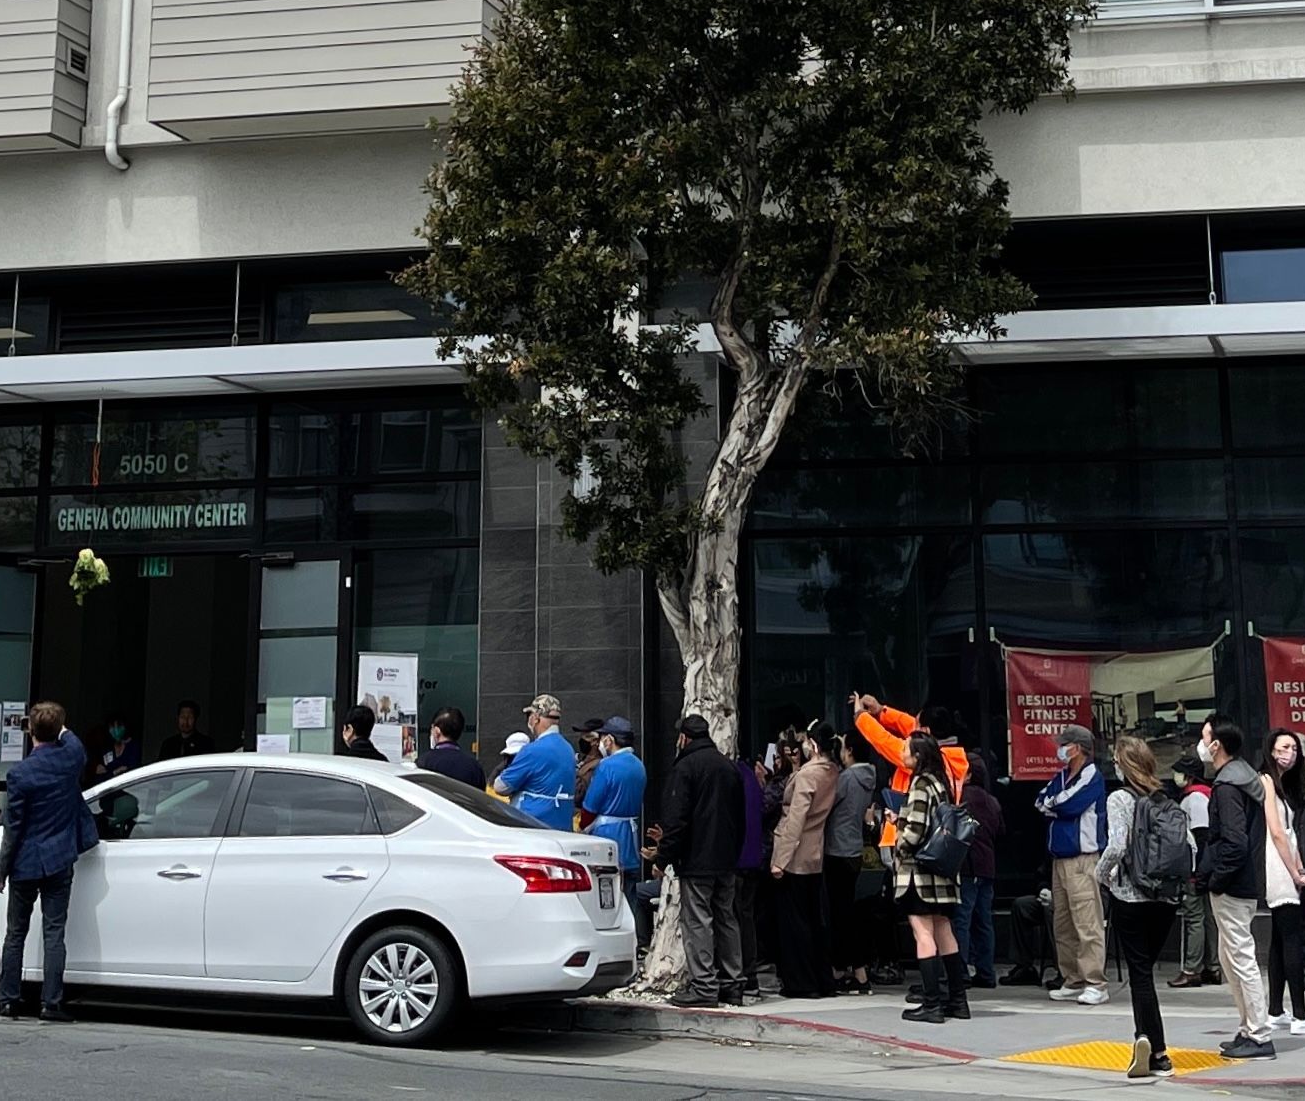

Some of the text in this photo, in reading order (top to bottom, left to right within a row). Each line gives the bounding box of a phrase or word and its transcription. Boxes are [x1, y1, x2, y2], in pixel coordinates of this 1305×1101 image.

[119, 453, 189, 475] 5050 C
[57, 502, 247, 532] GENEVA COMMUNITY CENTER
[1017, 695, 1082, 706] RESIDENT
[1023, 709, 1077, 720] FITNESS
